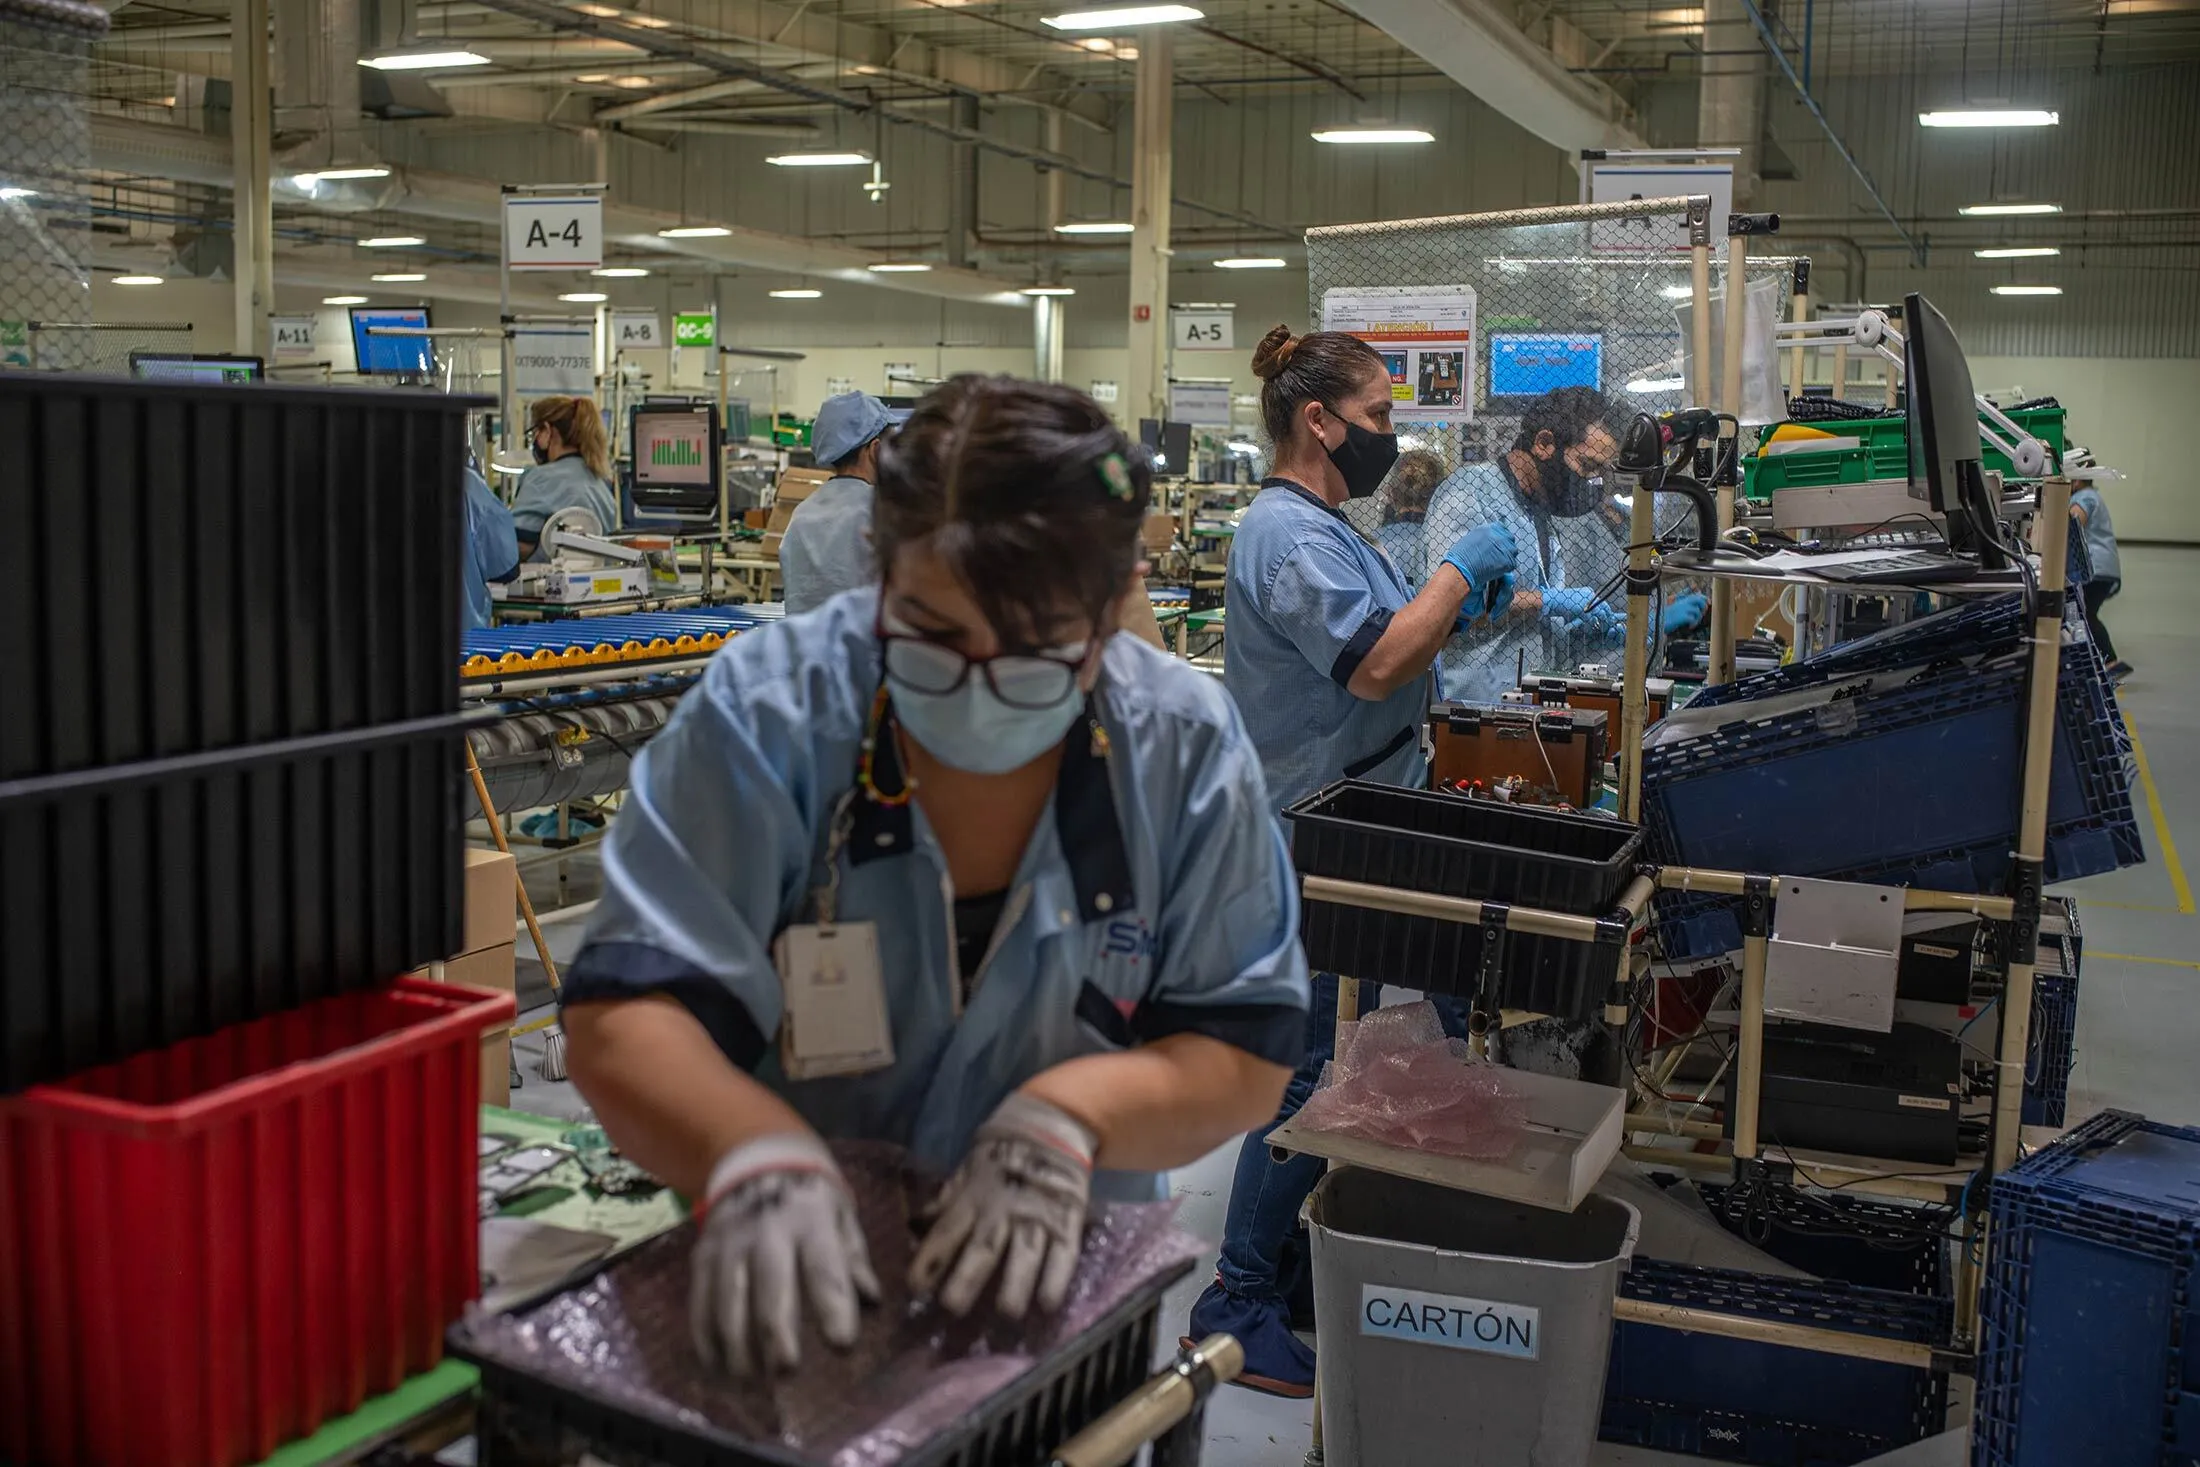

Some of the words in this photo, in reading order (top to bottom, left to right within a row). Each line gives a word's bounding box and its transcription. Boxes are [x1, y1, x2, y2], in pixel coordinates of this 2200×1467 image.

[526, 219, 583, 248] A-4
[277, 328, 310, 344] A-11
[622, 325, 651, 340] A-8
[1187, 324, 1222, 341] A-5
[1366, 1298, 1531, 1348] CARTÓN
